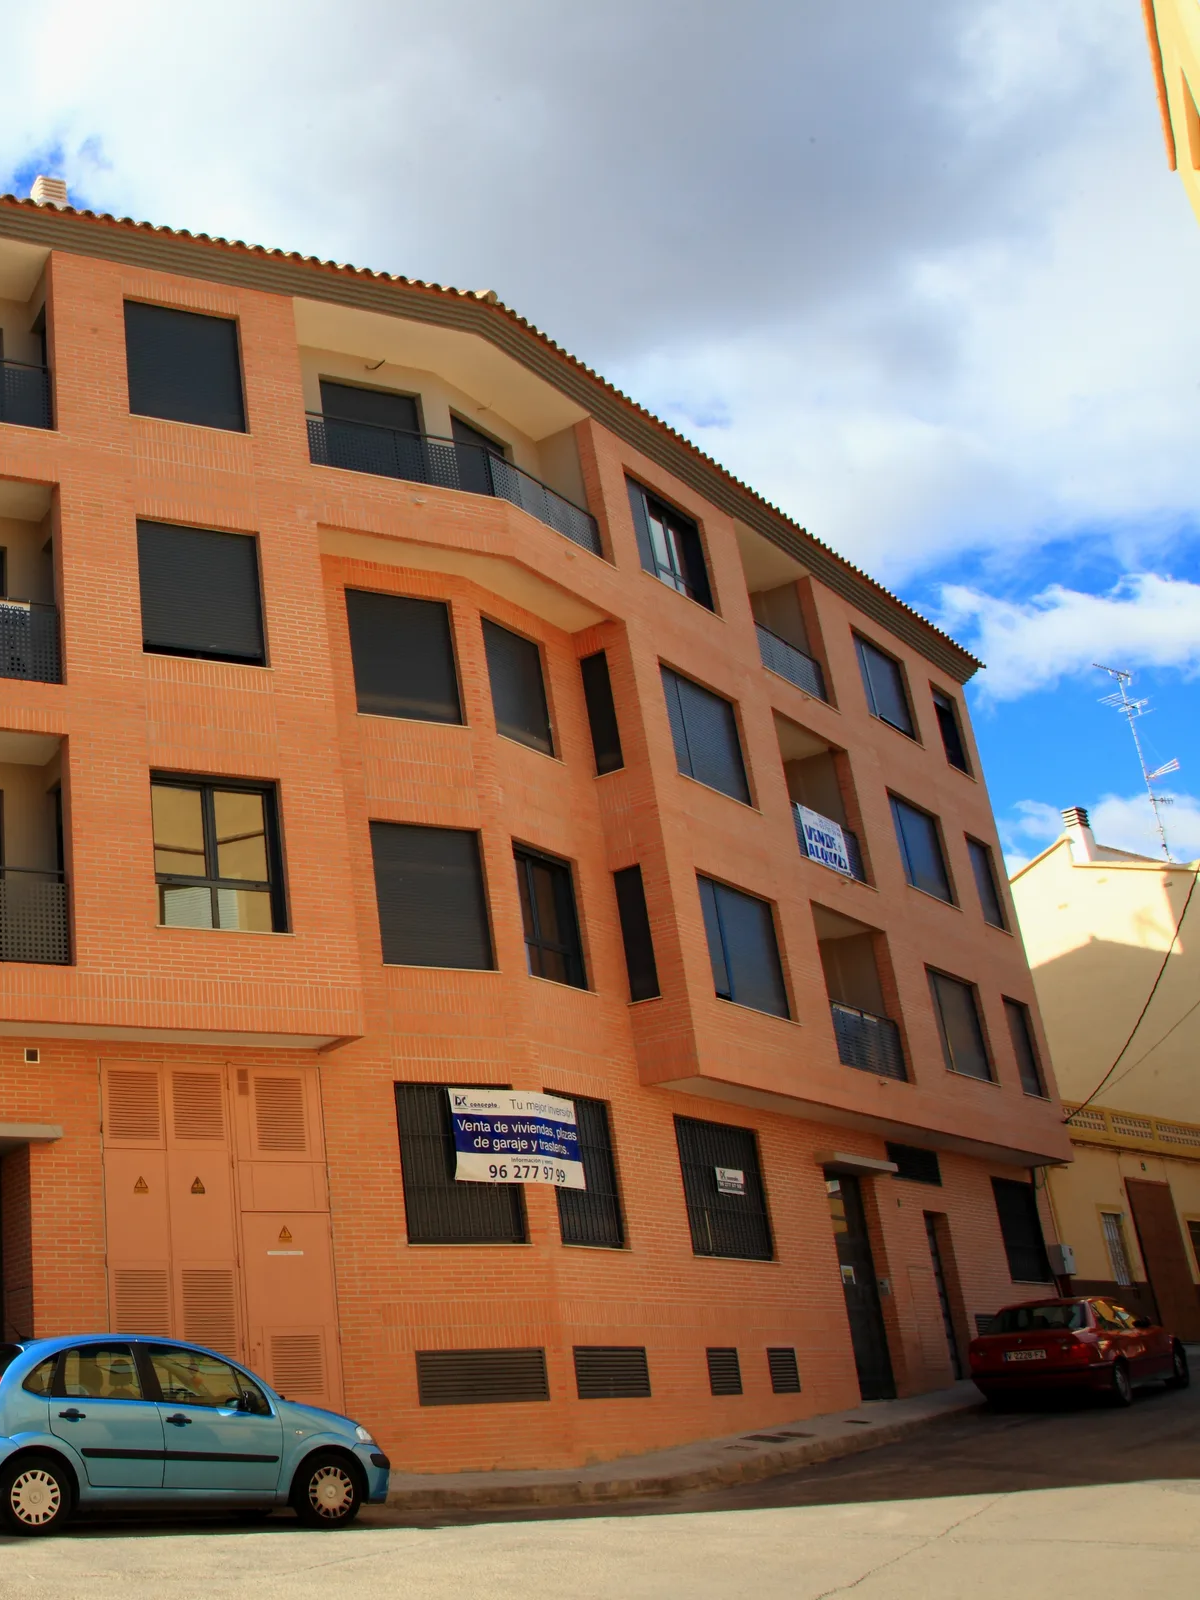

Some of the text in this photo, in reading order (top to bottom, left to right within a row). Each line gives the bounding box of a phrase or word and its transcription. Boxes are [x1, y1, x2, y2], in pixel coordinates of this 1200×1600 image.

[454, 1095, 467, 1107] DC
[509, 1099, 523, 1110] Tu
[526, 1101, 547, 1115] mejor
[457, 1119, 577, 1141] Venta de viviendas, plazas
[473, 1136, 570, 1155] de garaje y trasteros.
[488, 1164, 566, 1183] 96 277 97 99
